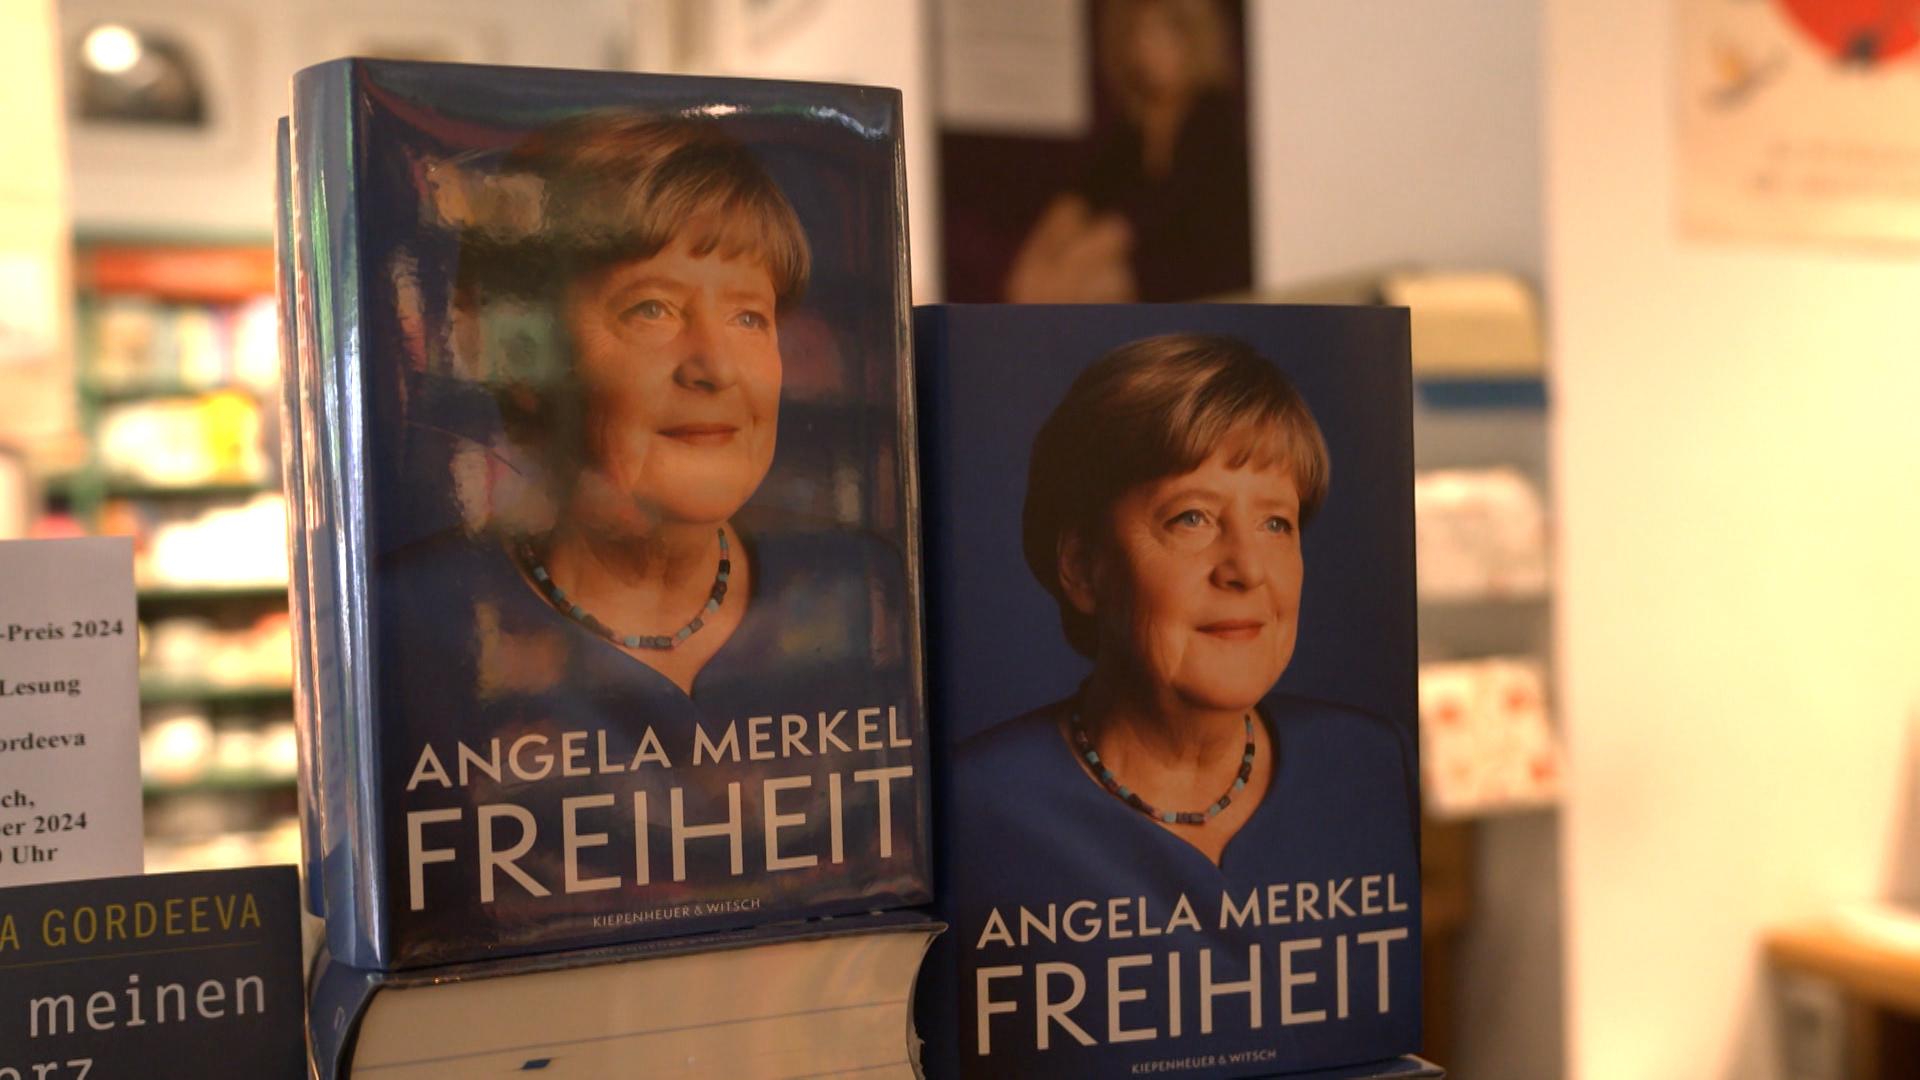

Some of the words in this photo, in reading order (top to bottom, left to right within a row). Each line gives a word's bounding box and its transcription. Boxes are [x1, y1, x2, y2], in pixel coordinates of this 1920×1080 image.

[72, 619, 124, 637] 2024
[0, 679, 81, 697] Lesung
[406, 725, 672, 791] ANGELA
[693, 705, 913, 766] MERKEL
[34, 812, 87, 834] 2024
[406, 766, 914, 911] FREIHEIT
[12, 845, 58, 864] Uhr
[42, 893, 261, 947] GORDEEVA
[592, 905, 690, 928] KIEPENHEUER
[693, 906, 703, 917] &
[705, 898, 761, 915] WITSCH
[976, 892, 1201, 950] ANGELA
[1219, 873, 1408, 929] MERKEL
[29, 973, 265, 1038] meinen
[976, 928, 1408, 1056] FREIHEIT
[1131, 1055, 1216, 1074] KIEPENHEUER
[1229, 1049, 1277, 1064] WITSCH
